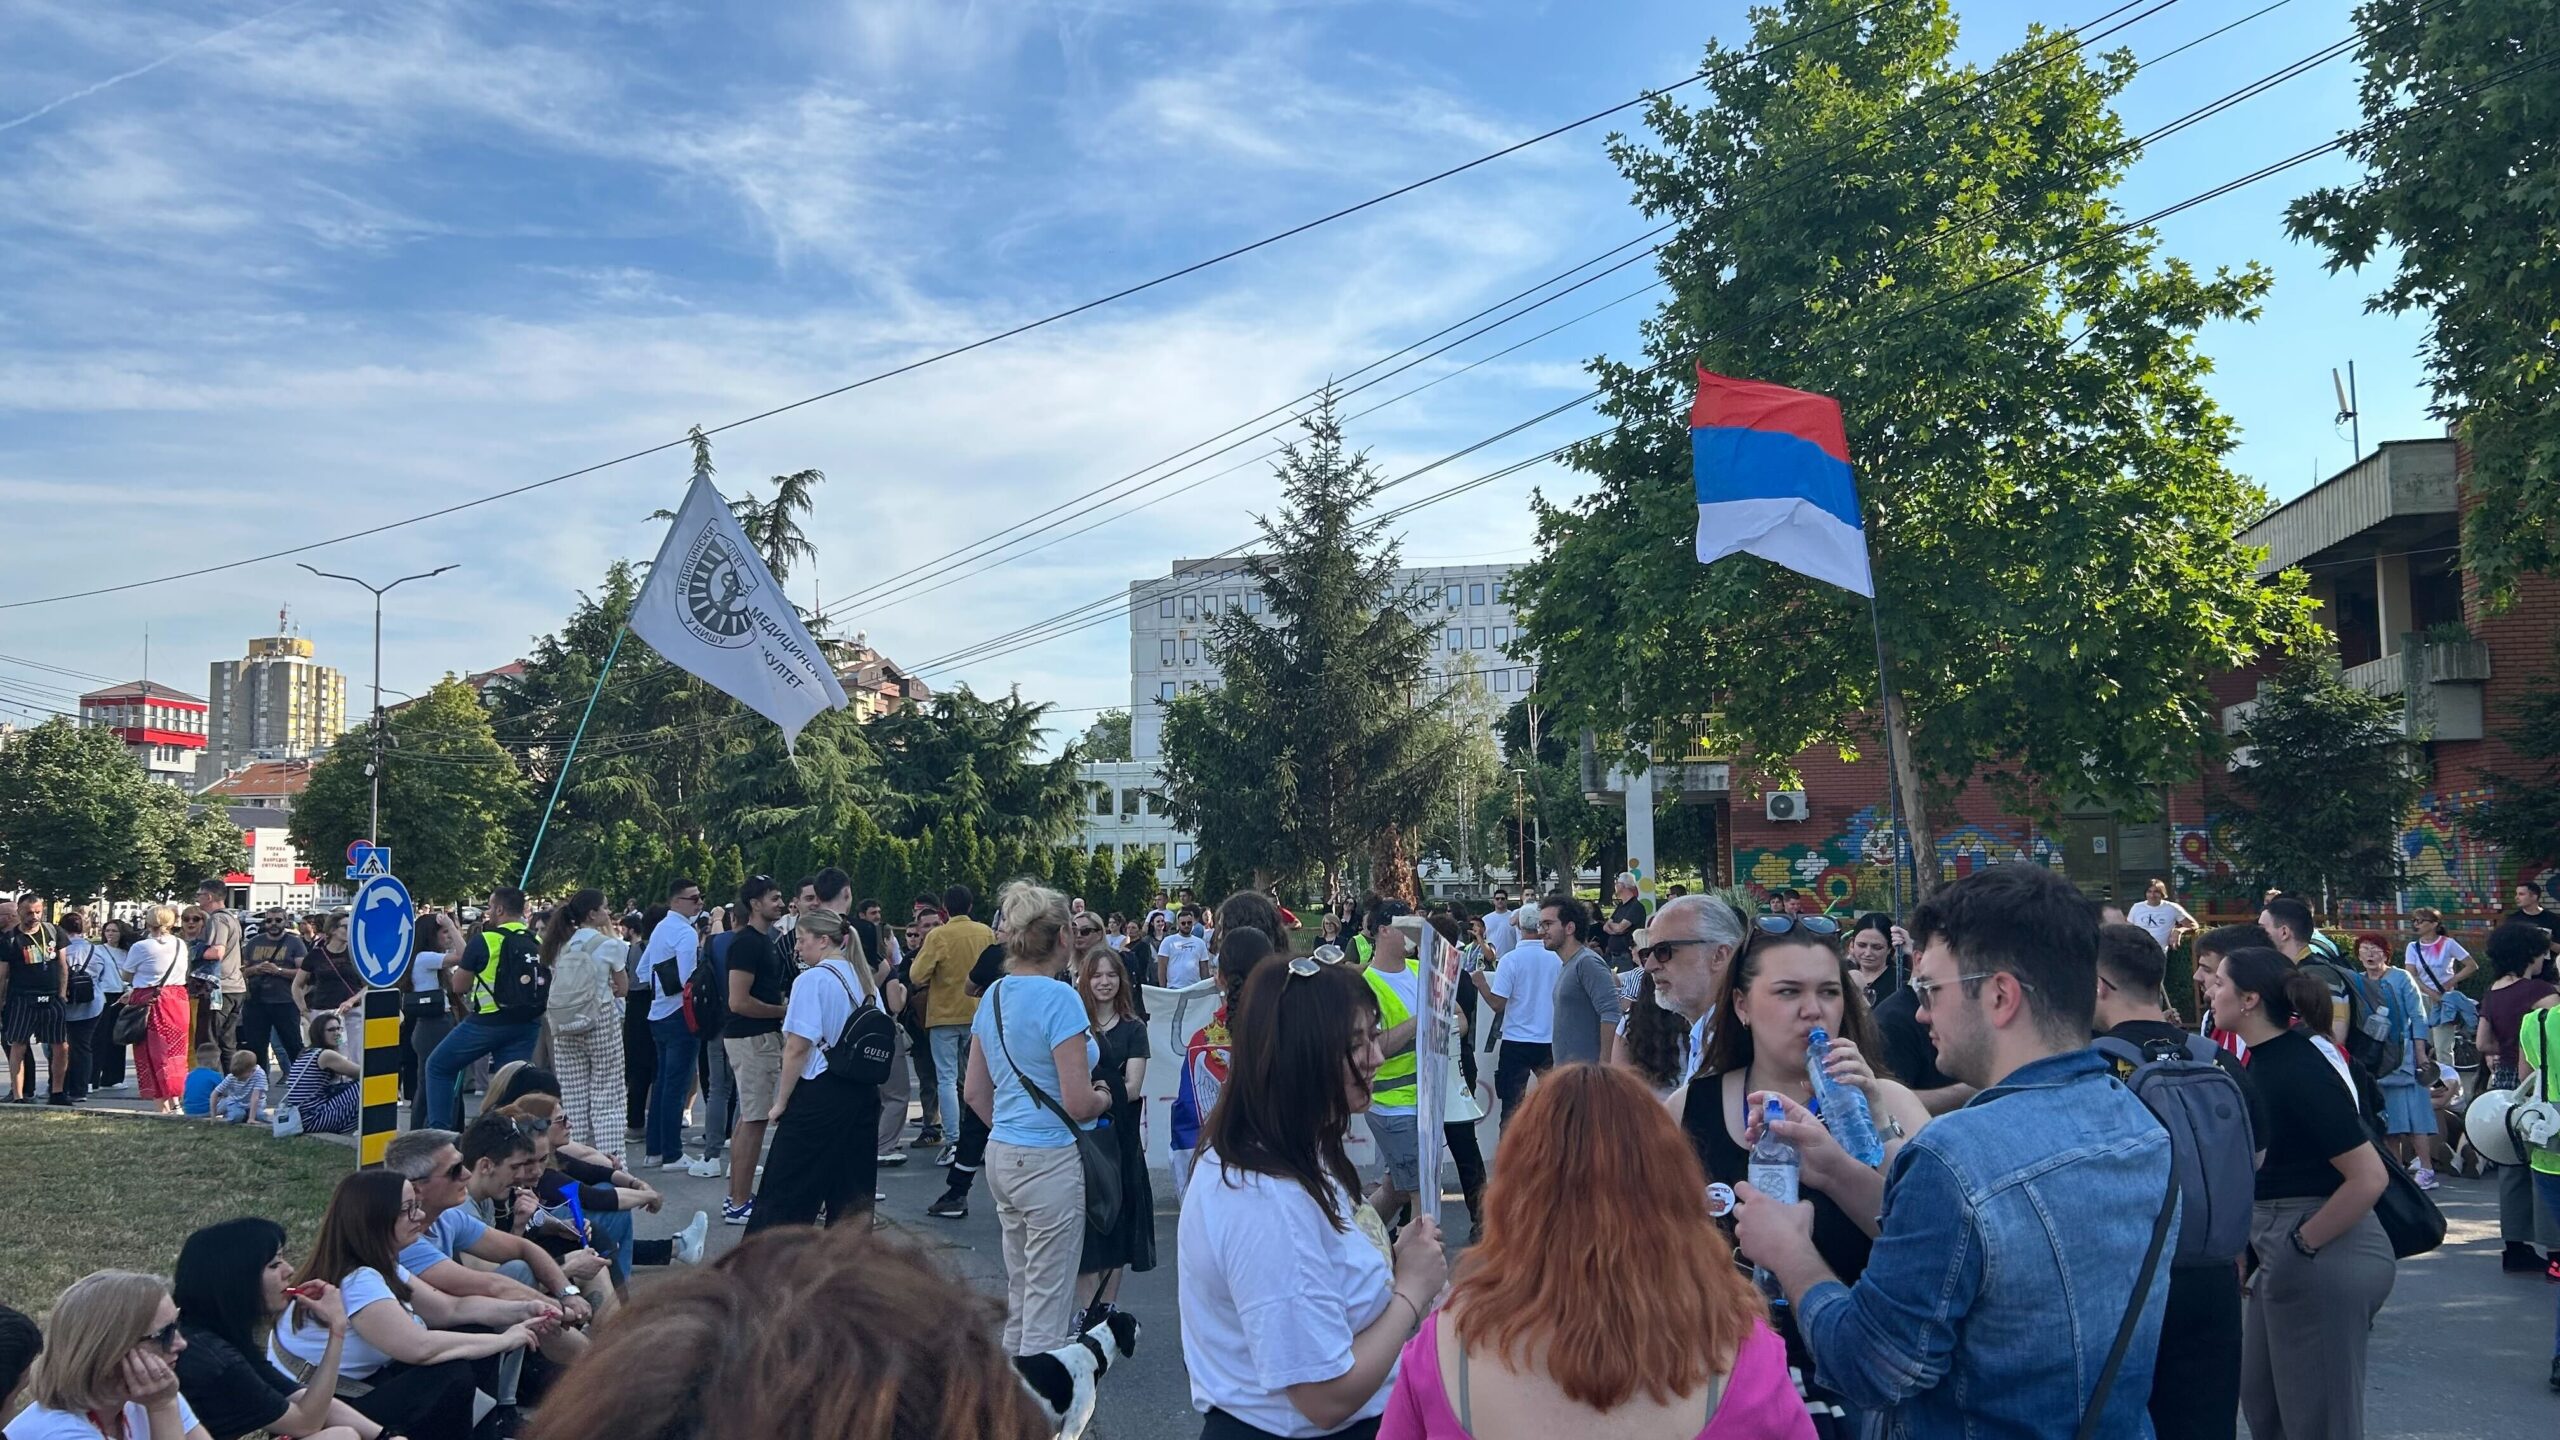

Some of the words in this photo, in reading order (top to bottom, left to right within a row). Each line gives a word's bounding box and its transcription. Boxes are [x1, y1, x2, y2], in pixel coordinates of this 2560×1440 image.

[678, 526, 716, 595] МЕДИЦИНСКИ
[693, 624, 727, 645] НИШУ
[751, 606, 821, 682] МЕДИЦИНС
[863, 1046, 890, 1059] GUESS
